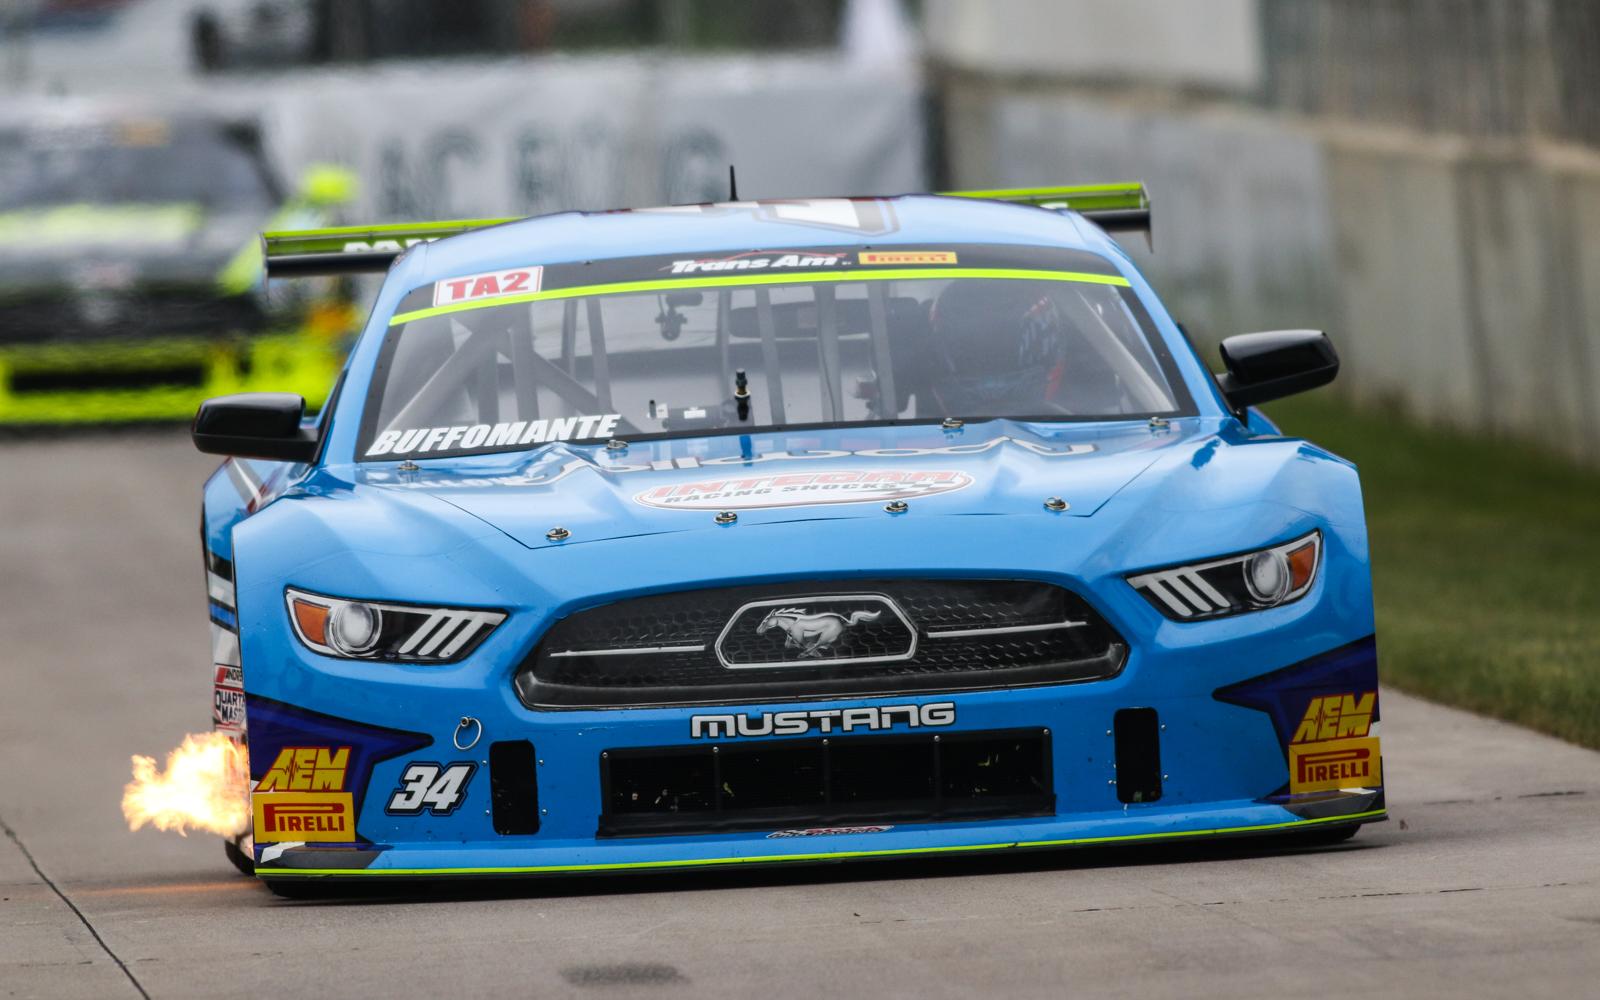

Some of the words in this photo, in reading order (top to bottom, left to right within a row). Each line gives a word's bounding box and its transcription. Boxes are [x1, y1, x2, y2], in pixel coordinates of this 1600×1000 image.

[671, 258, 770, 274] Trans
[770, 254, 838, 268] Am
[447, 271, 530, 300] TA2
[365, 414, 621, 456] BUFFOMANTE
[651, 470, 957, 498] INTEGRA
[664, 489, 772, 503] RACING
[783, 483, 897, 492] SHOCKS
[691, 701, 955, 738] MUSTANG
[1292, 692, 1376, 742] AEM
[255, 747, 351, 792] AEM
[1297, 748, 1370, 783] PIRELLI
[387, 763, 474, 812] 34
[262, 803, 345, 833] PIRELLI
